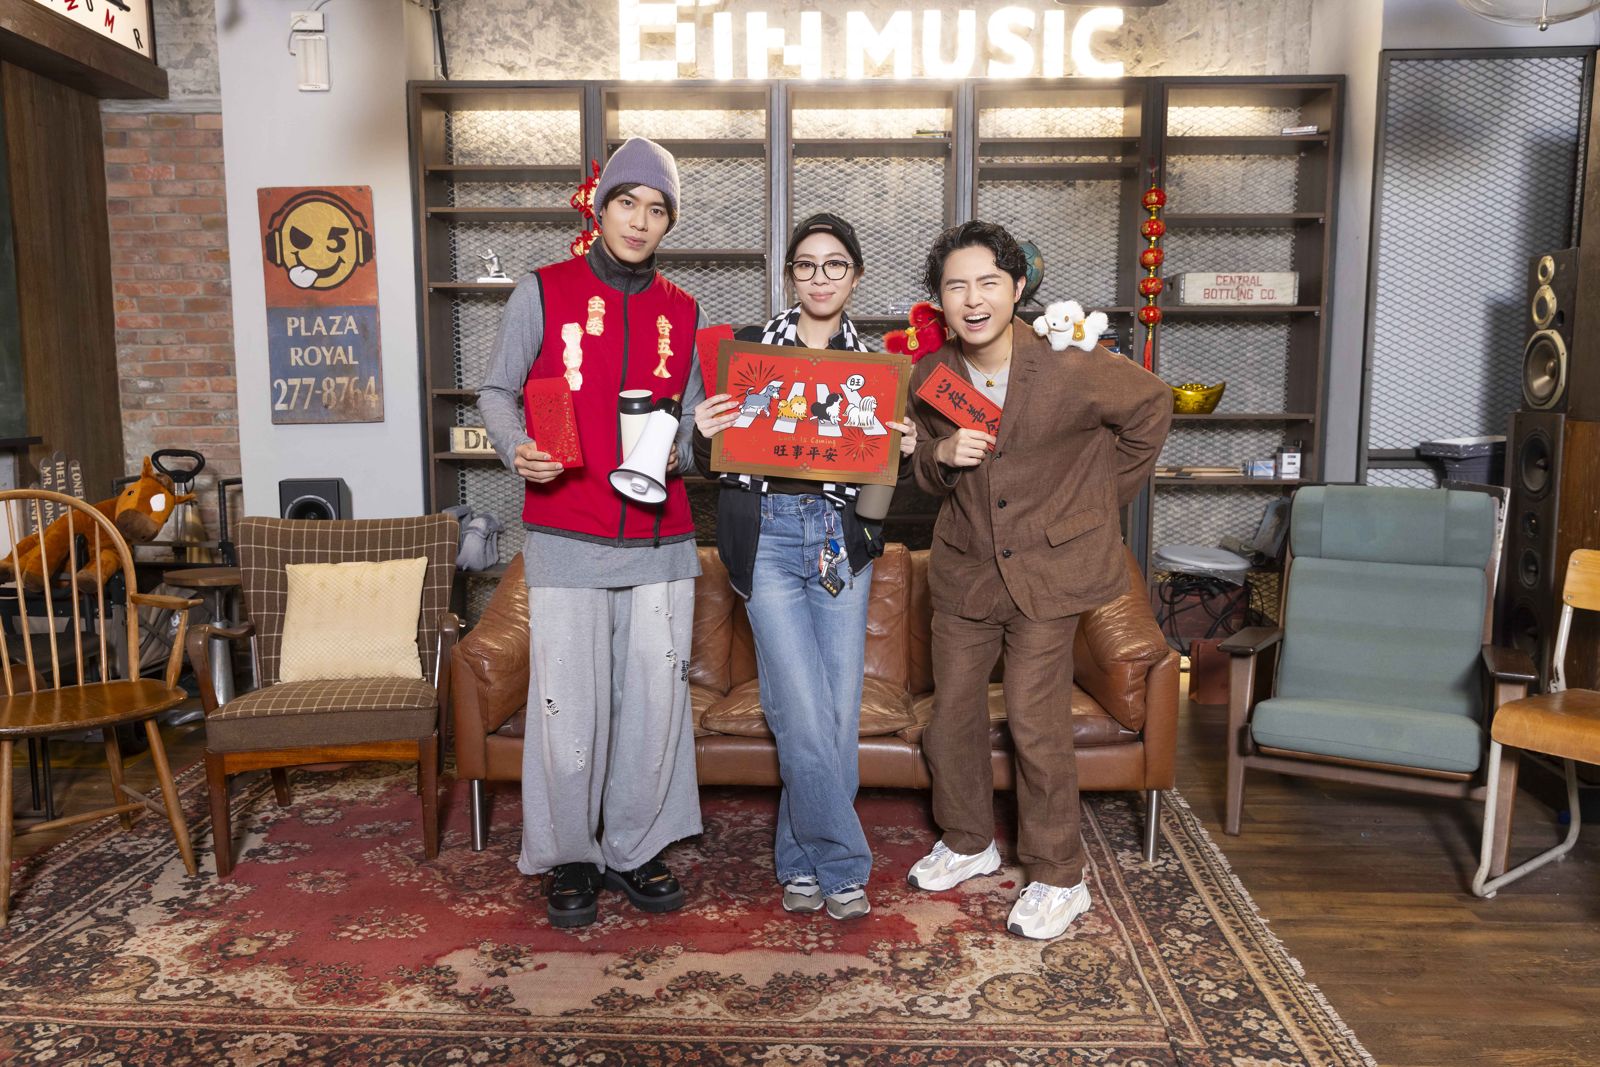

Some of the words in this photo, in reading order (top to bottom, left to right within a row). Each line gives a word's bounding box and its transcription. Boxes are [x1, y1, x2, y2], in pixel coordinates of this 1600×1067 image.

[133, 28, 144, 49] R
[619, 0, 821, 80] BIN
[846, 6, 1124, 79] MUSIC
[1216, 275, 1262, 286] CENTRAL
[1203, 288, 1254, 300] BOTTLING
[1260, 288, 1277, 300] CO.
[287, 315, 359, 336] PLAZA
[290, 346, 358, 366] ROYAL
[849, 377, 861, 386] 旺
[273, 376, 378, 411] 277-8764
[774, 445, 838, 462] 旺事平安
